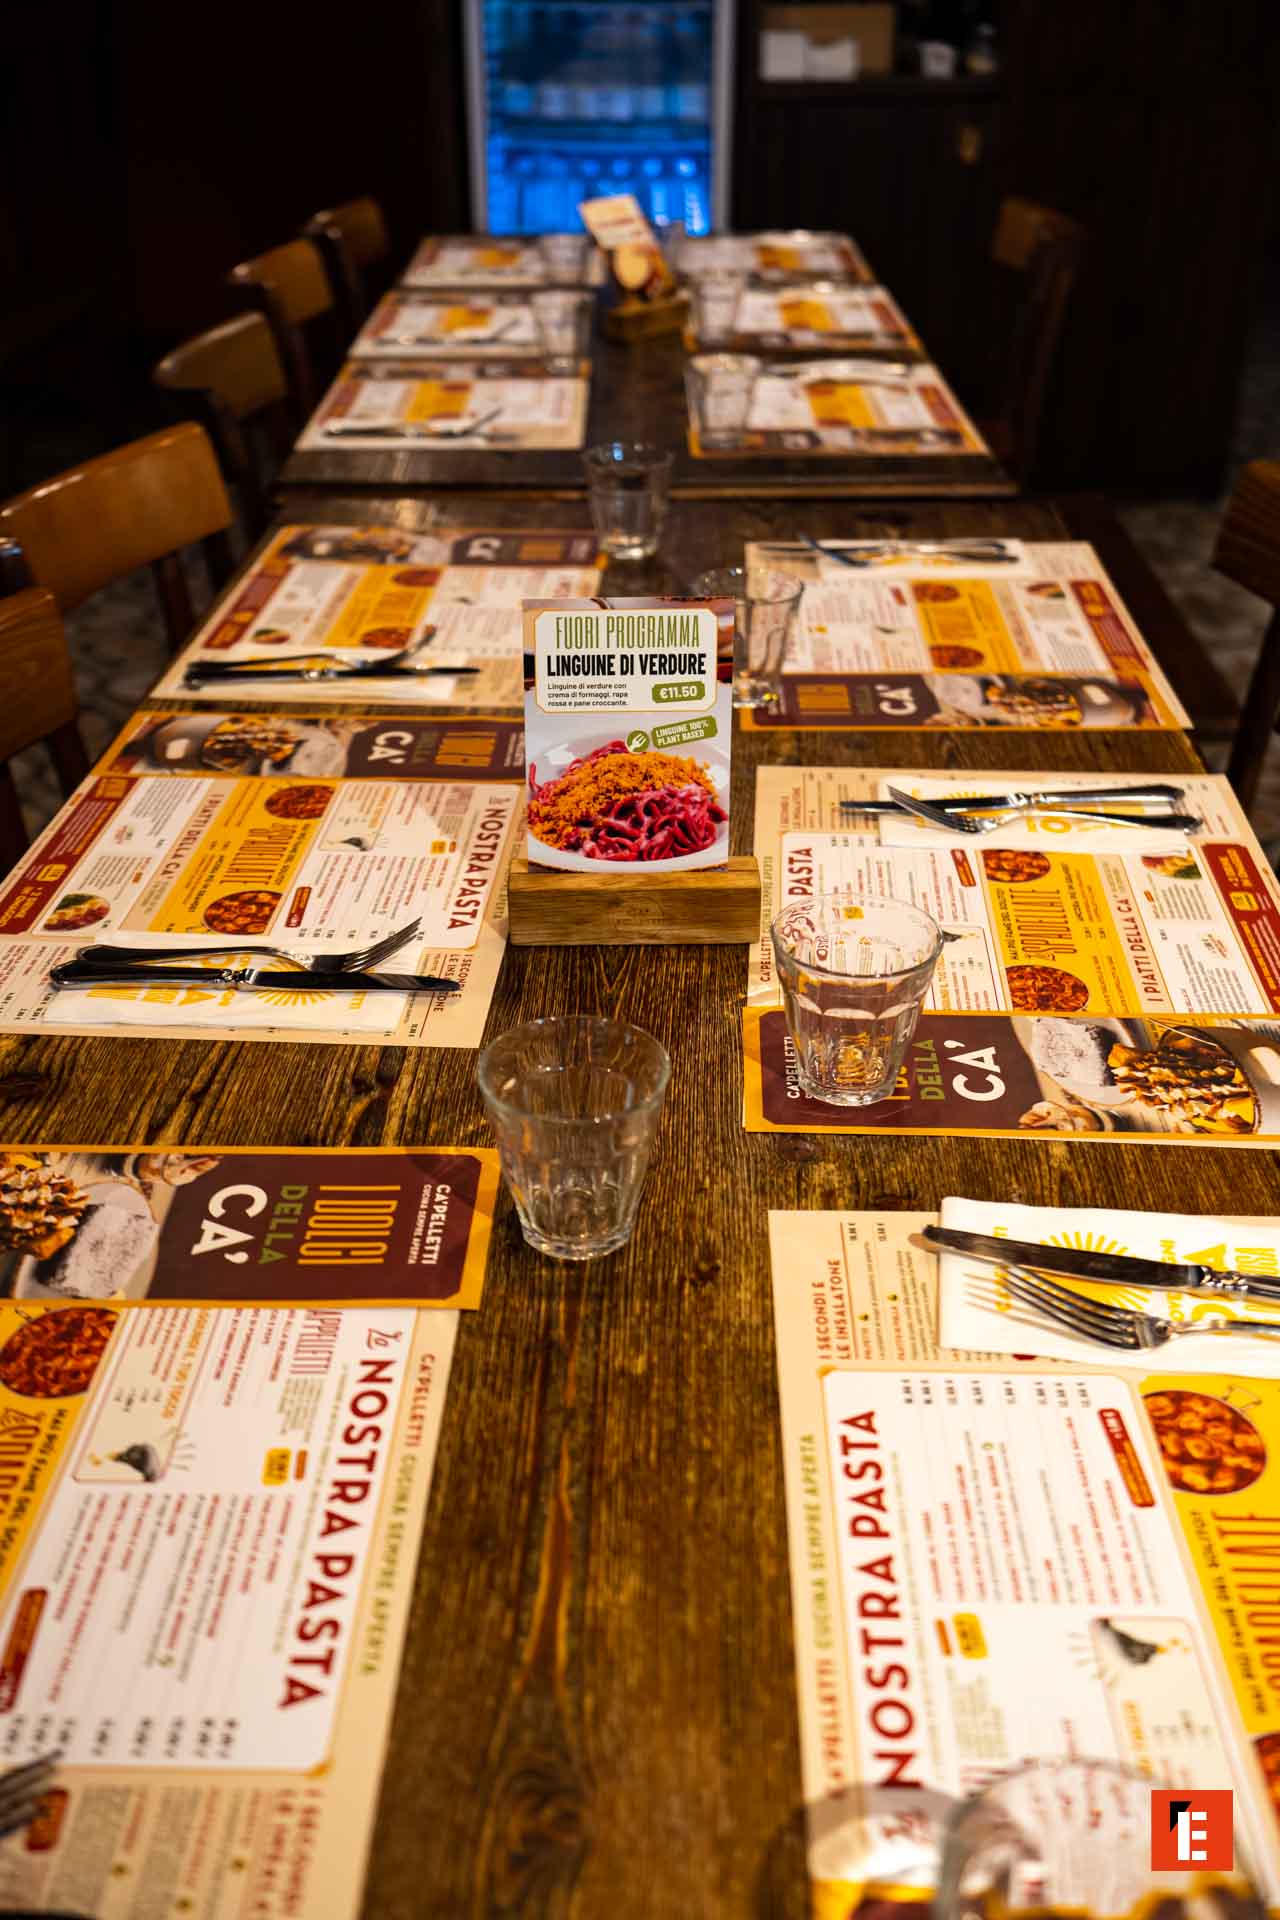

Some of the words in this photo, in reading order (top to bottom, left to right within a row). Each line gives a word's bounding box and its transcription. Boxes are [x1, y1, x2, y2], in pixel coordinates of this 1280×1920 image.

[556, 617, 599, 649] FUORI
[607, 615, 700, 648] PROGRAMMA
[547, 654, 616, 676] LINGUINE
[620, 654, 634, 675] DI
[640, 653, 706, 675] VERDURE
[660, 686, 697, 699] €11.50
[655, 722, 688, 737] LINGUINE
[657, 736, 681, 746] PLANT
[192, 800, 221, 827] PIATTI
[464, 808, 508, 874] NOSTRA
[171, 830, 200, 858] DELLA
[788, 847, 814, 896] PASTA
[447, 878, 485, 929] PASTA
[1010, 887, 1077, 954] SPADELLATE
[760, 936, 771, 982] CA'PELLETTI
[1123, 916, 1147, 951] DELLA
[1133, 955, 1161, 994] PIATTI
[913, 1039, 945, 1100] DELLA
[944, 1040, 1006, 1101] CA'
[319, 1184, 401, 1192] I
[419, 1184, 432, 1209] CUCINA
[190, 1184, 269, 1264] CA'
[258, 1184, 309, 1265] DELLA
[296, 1199, 398, 1265] DOLCI
[412, 1210, 428, 1236] SEMPRE
[421, 1184, 451, 1265] CA'PELLETTI
[407, 1237, 422, 1265] APERTA
[811, 1281, 825, 1289] E
[827, 1259, 849, 1340] INSALATONE
[1166, 1293, 1184, 1321] OVE
[812, 1292, 830, 1351] SECONDI
[836, 1344, 850, 1359] LE
[405, 1353, 436, 1448] CA'PELLETTI
[319, 1358, 397, 1539] NOSTRA
[800, 1433, 820, 1497] APERTA
[839, 1411, 890, 1538] PASTA
[393, 1454, 418, 1515] CUCINA
[377, 1522, 406, 1590] SEMPRE
[276, 1552, 356, 1711] PASTA
[359, 1597, 392, 1677] APERTA
[856, 1556, 922, 1790] NOSTRA
